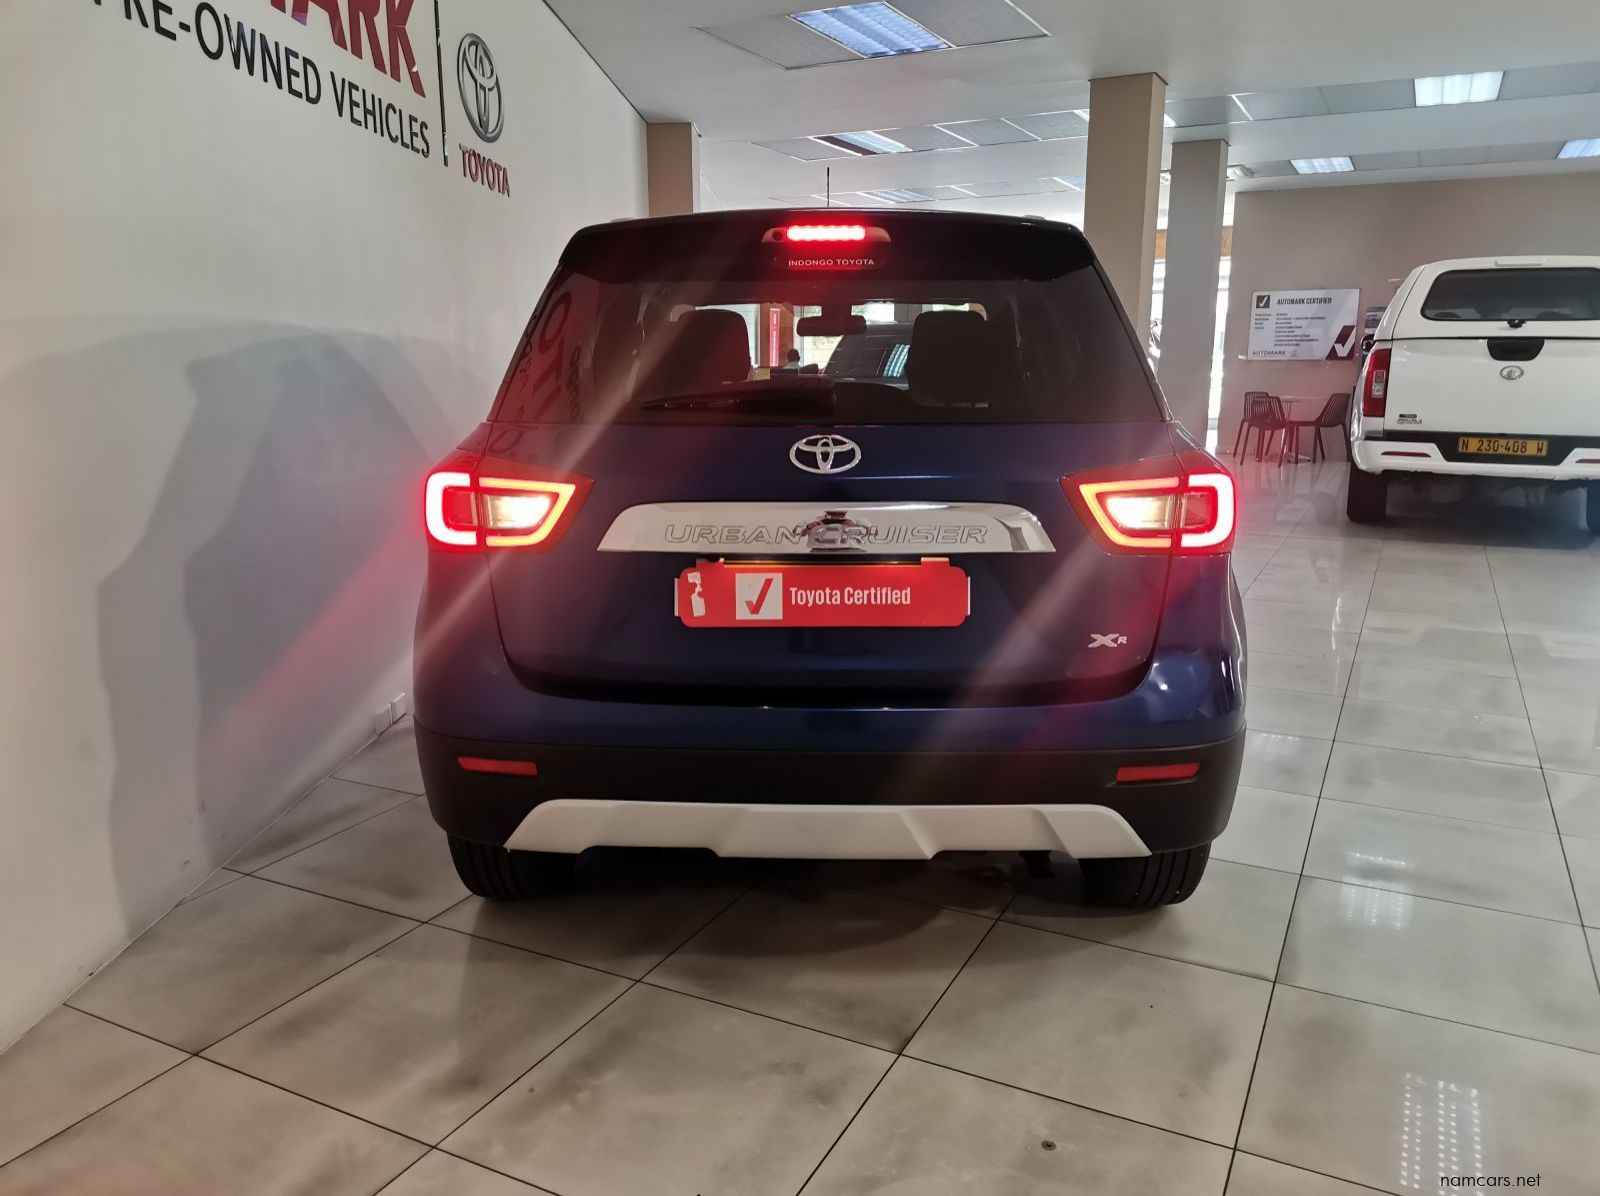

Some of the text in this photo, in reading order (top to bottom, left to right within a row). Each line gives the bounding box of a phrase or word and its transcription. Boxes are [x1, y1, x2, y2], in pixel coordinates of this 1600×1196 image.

[330, 71, 430, 158] VEHICLES
[459, 143, 510, 198] TOYOTA
[788, 258, 875, 267] INDONGO TOYOTA
[1277, 297, 1332, 306] AUTOMARK CERTIFIED
[1461, 439, 1544, 454] N 230-408 W
[664, 524, 988, 544] URBAN CRUISER
[789, 586, 911, 607] Toyota Certified
